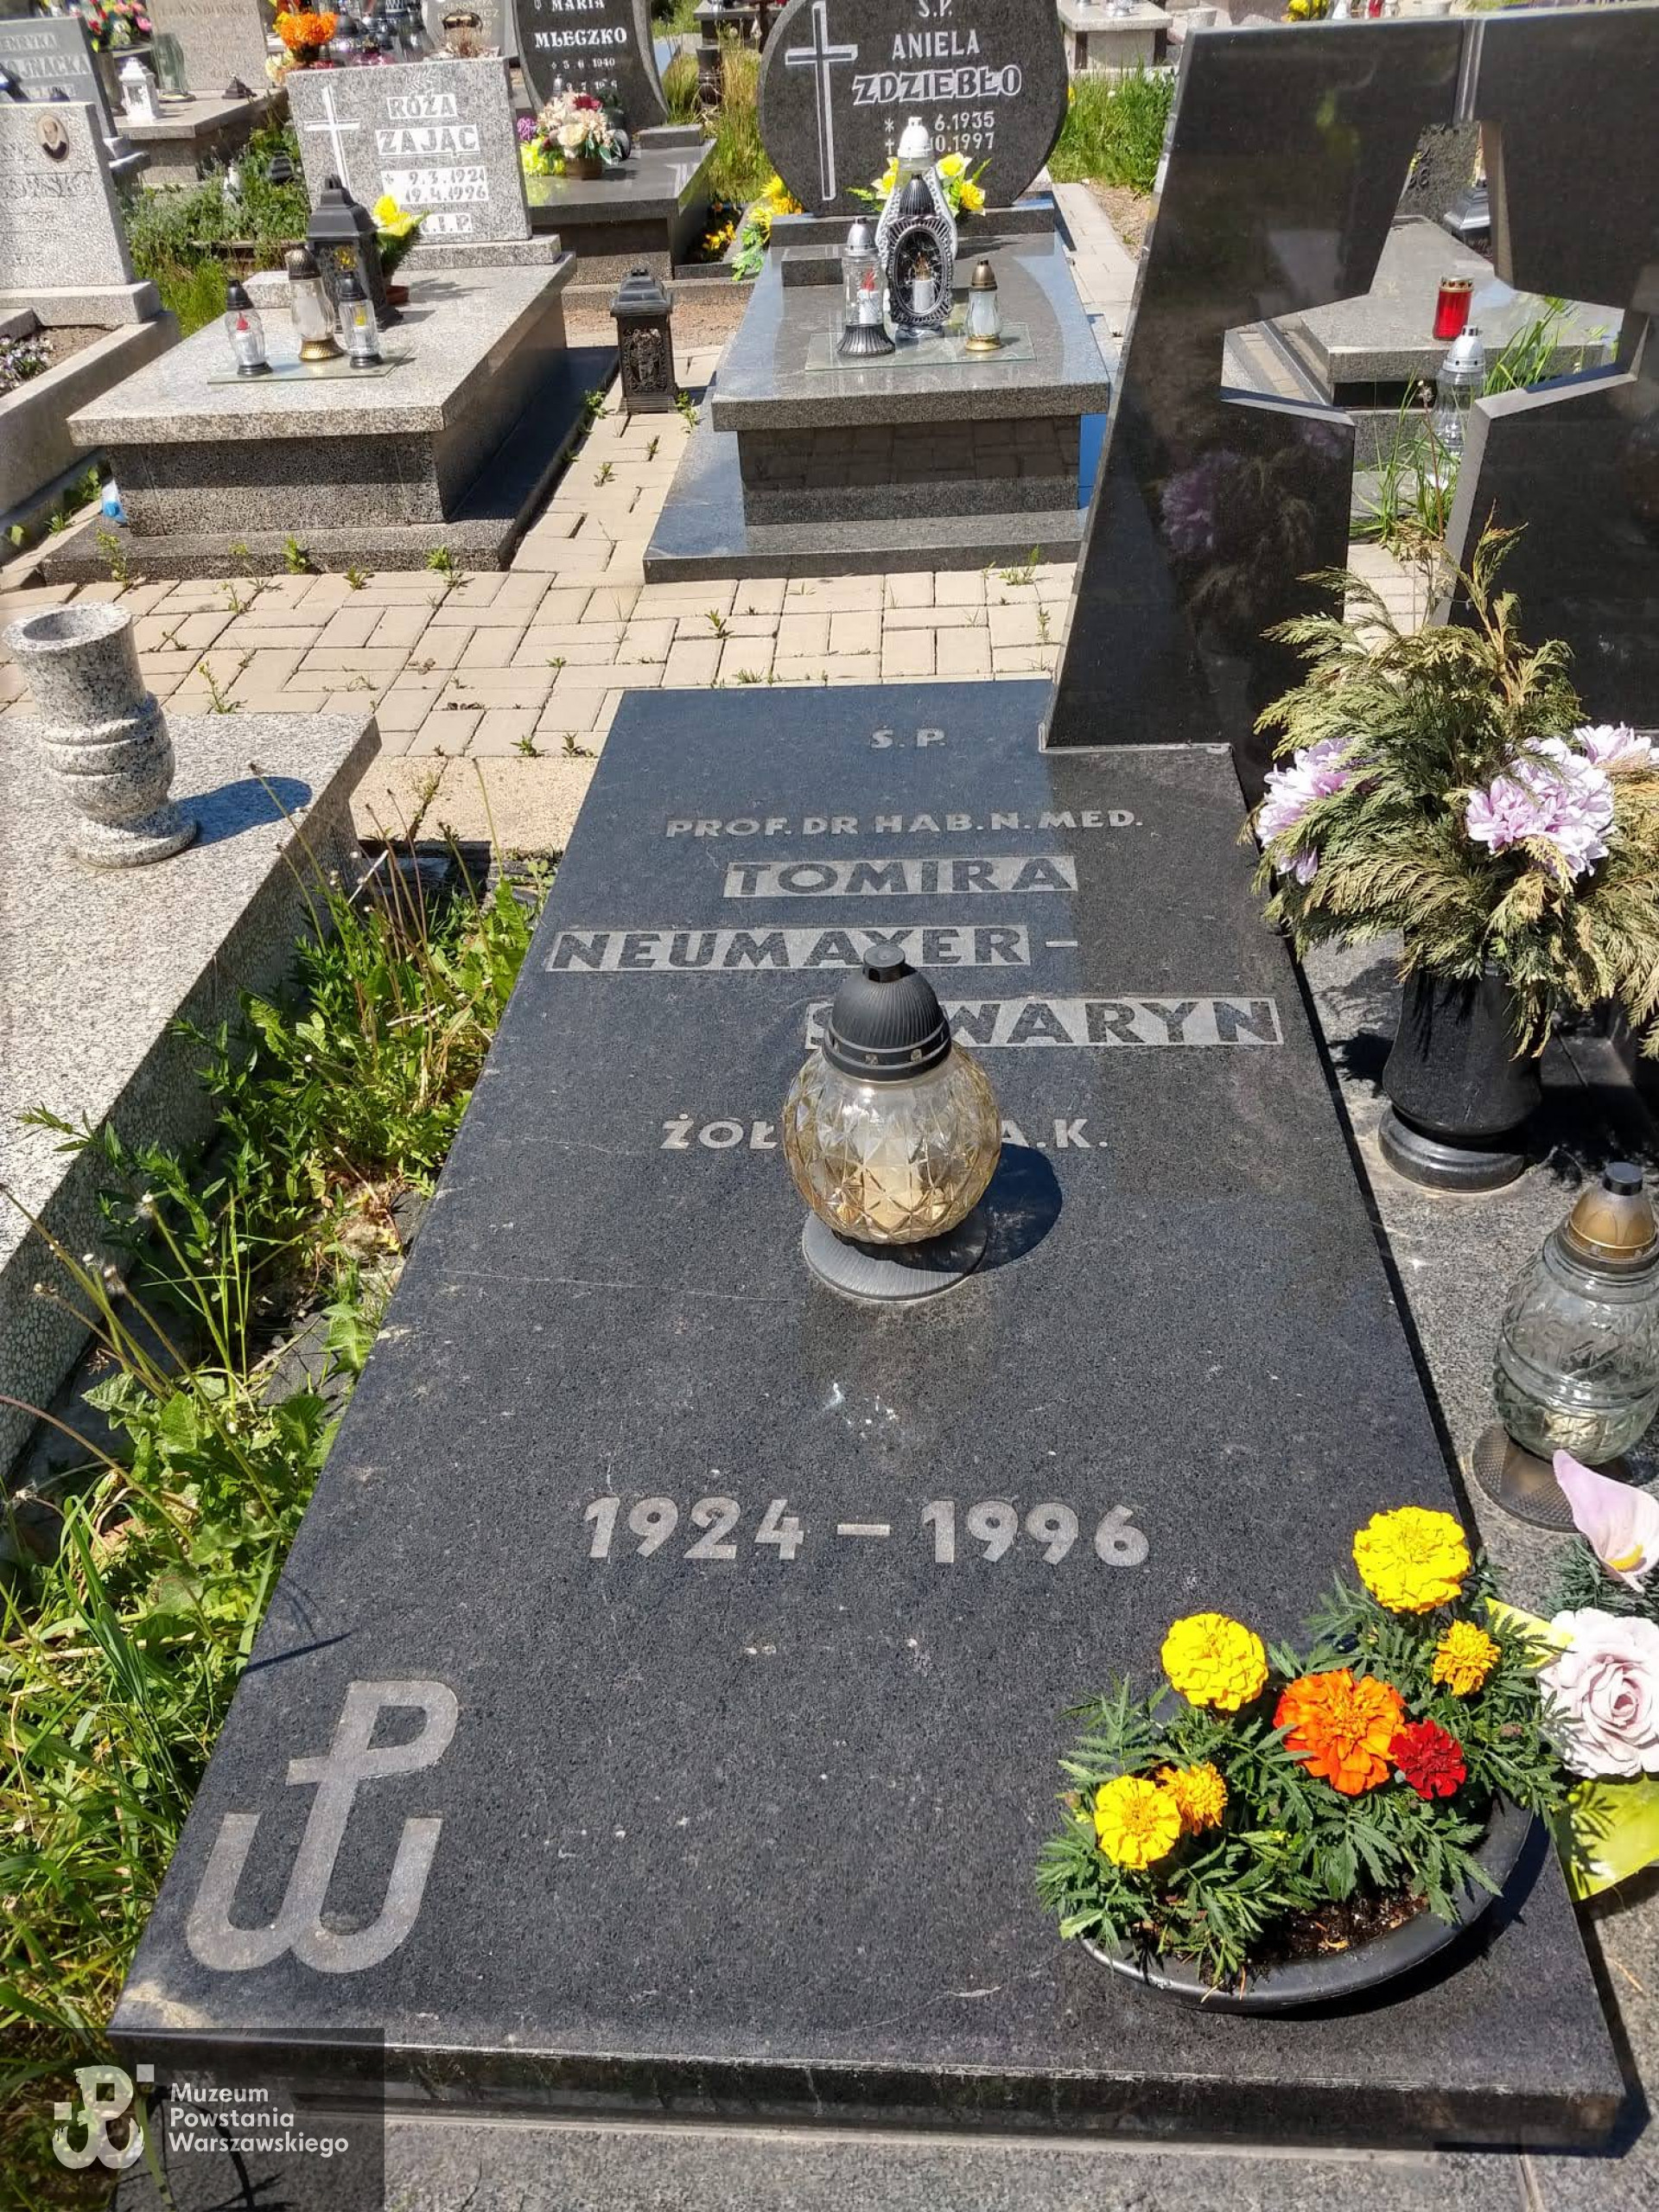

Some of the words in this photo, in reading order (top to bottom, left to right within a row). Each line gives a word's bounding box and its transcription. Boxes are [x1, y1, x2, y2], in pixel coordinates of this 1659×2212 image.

[551, 0, 605, 12] MARIA
[892, 29, 981, 60] ANIELA
[851, 64, 1022, 106] ZDZIEBŁO
[388, 88, 457, 118] RÓŻA
[378, 126, 479, 157] ZAJĄC
[665, 817, 792, 838] PROF.
[801, 816, 859, 836] DR
[727, 855, 1076, 898] TOMIRA
[583, 1496, 804, 1560] 1924
[921, 1499, 1150, 1567] 1996
